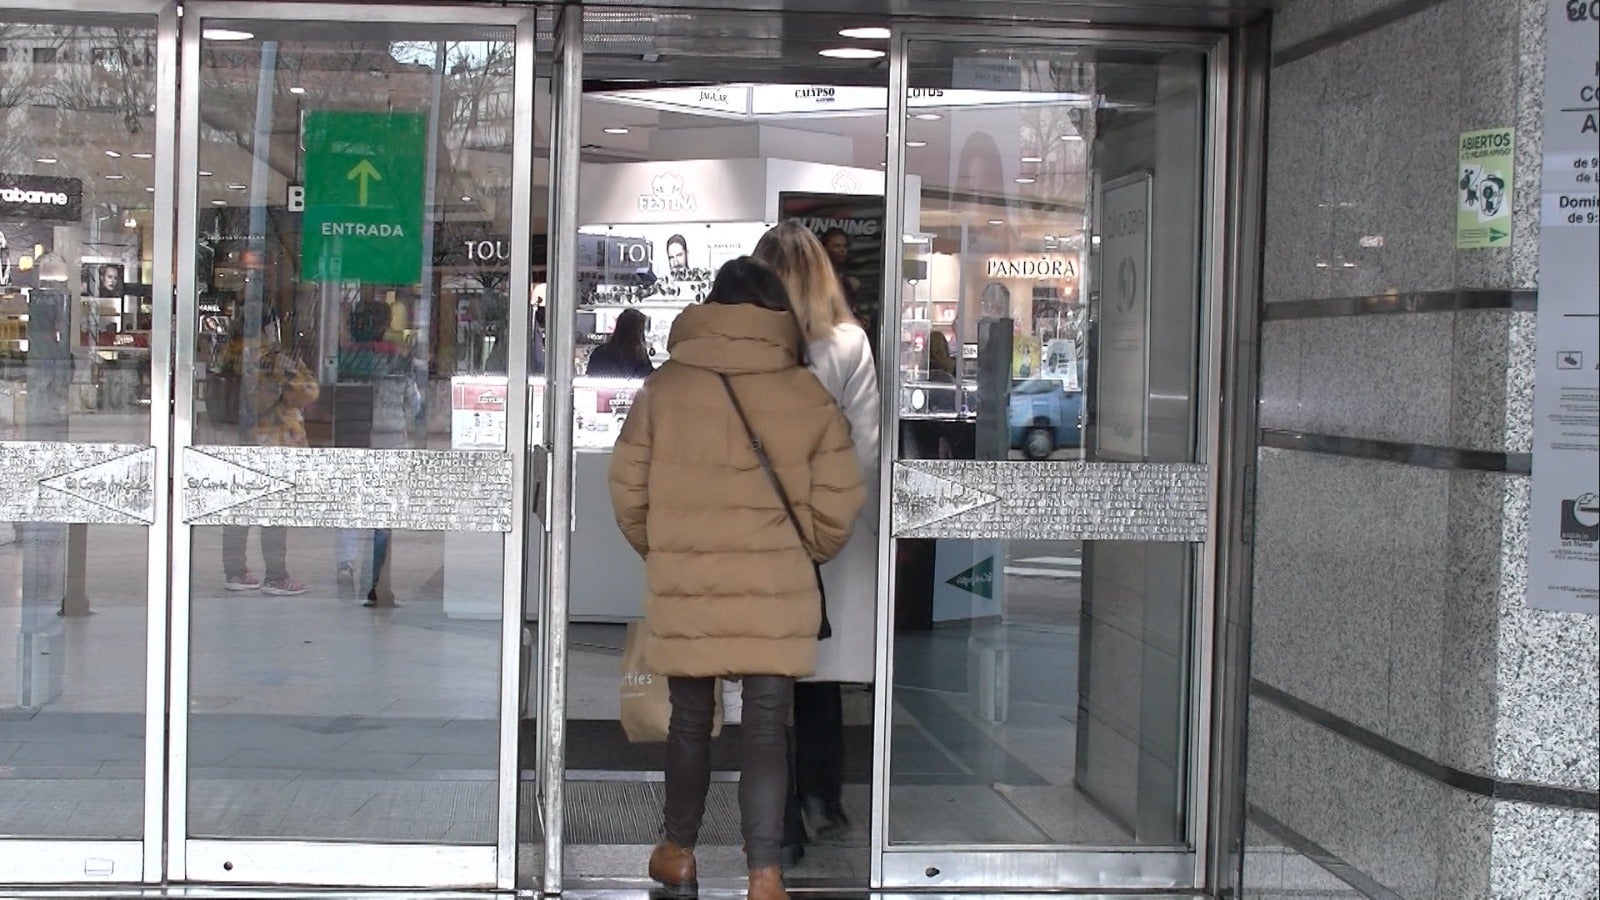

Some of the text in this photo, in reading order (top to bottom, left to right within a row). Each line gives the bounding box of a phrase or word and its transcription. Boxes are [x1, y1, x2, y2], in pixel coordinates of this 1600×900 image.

[794, 87, 836, 99] CALYPSO
[1460, 132, 1511, 151] ABIERTOS
[1573, 157, 1588, 168] de
[1576, 173, 1591, 183] de
[1567, 212, 1583, 223] de
[321, 222, 405, 238] ENTRADA
[987, 256, 1077, 277] PANDORA
